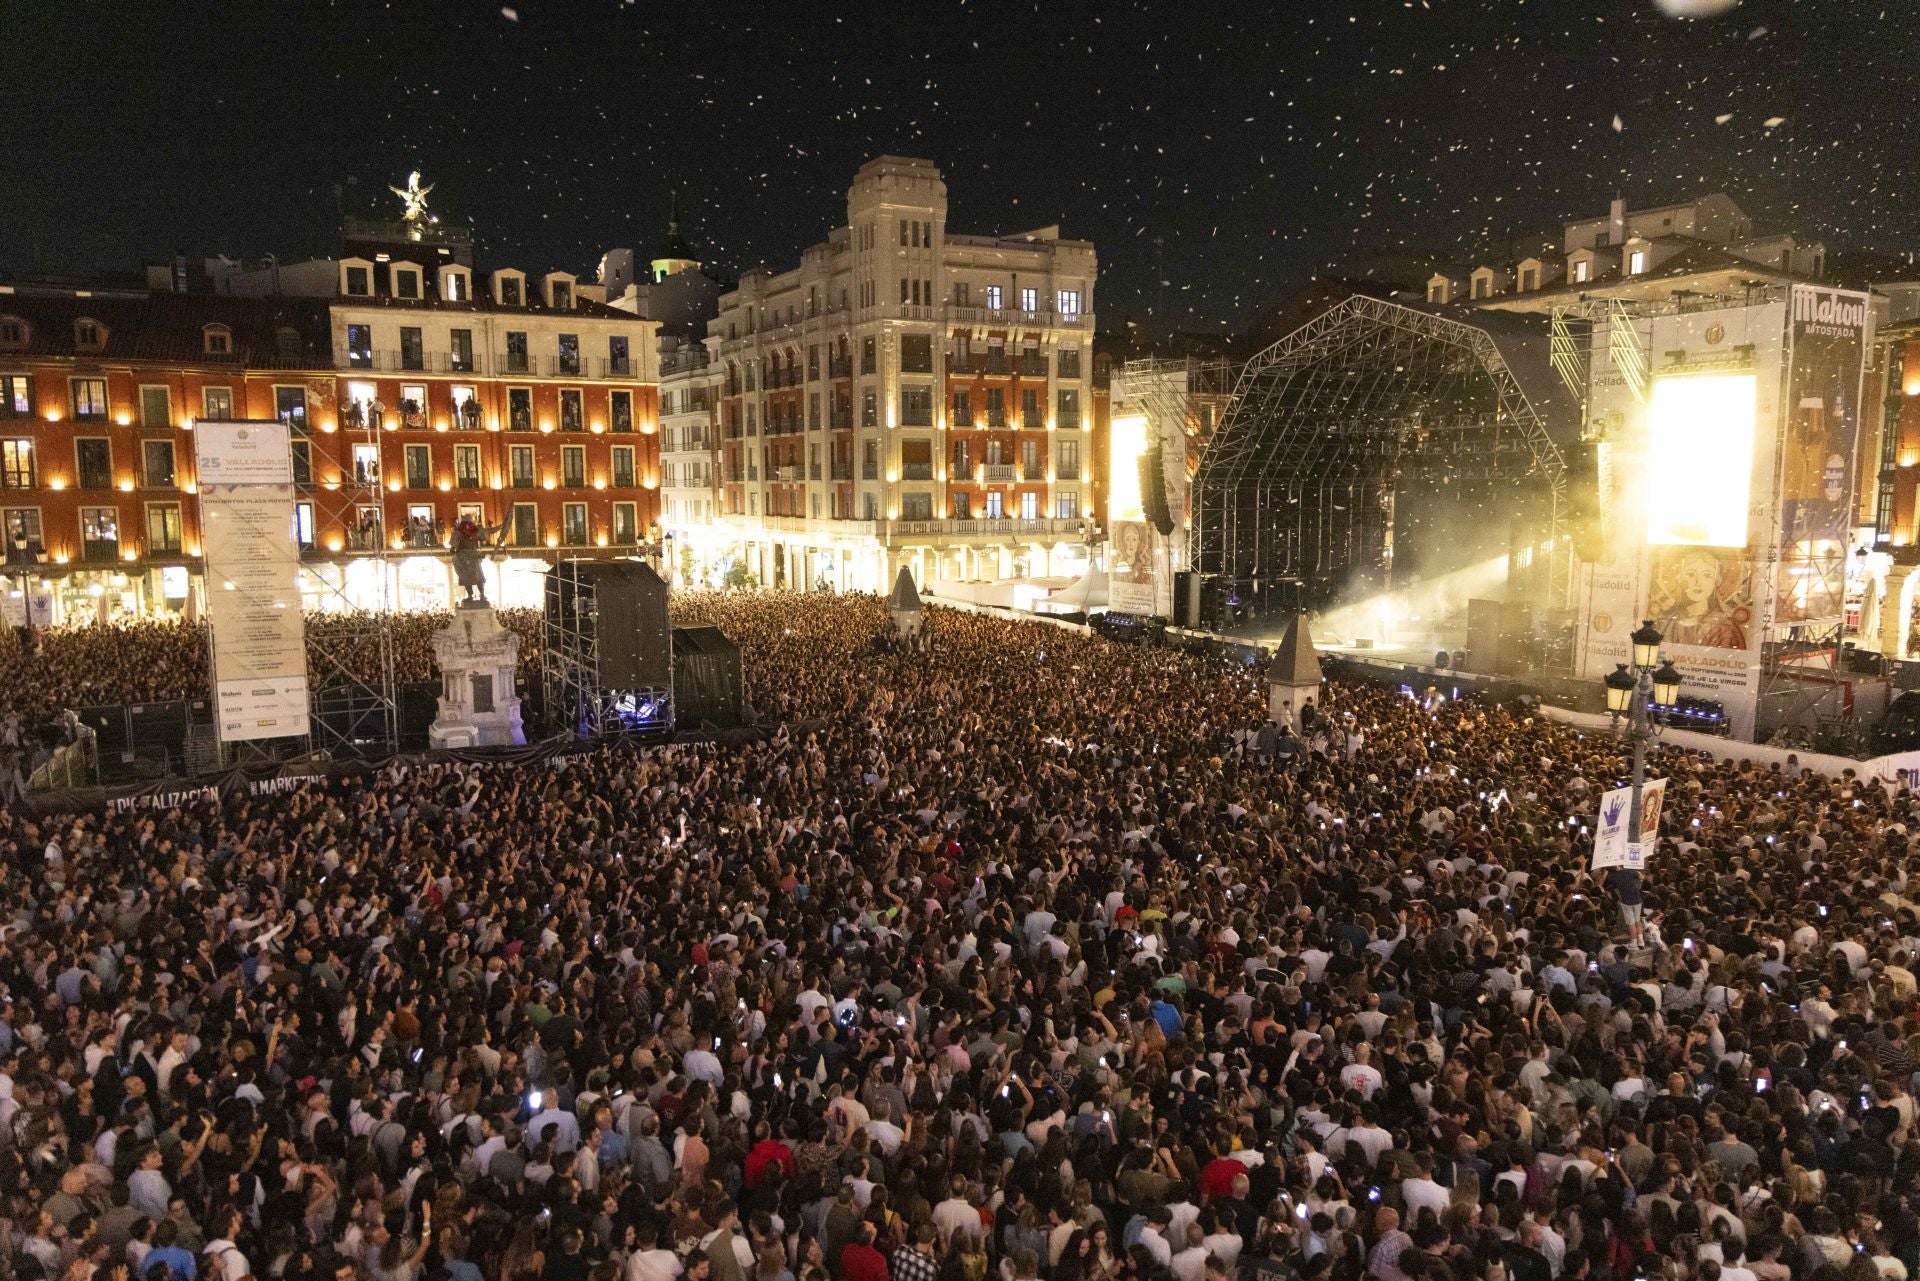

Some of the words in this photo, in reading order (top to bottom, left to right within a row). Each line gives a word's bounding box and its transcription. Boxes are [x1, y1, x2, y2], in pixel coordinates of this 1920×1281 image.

[1795, 290, 1864, 327] Mahou
[1816, 325, 1855, 338] TOSTADA
[201, 457, 220, 468] 25
[1585, 578, 1631, 591] Valladolid
[1673, 655, 1748, 670] VALLADOLID
[1691, 667, 1727, 676] SEPTIEMBRE
[1689, 682, 1719, 690] LORENZO
